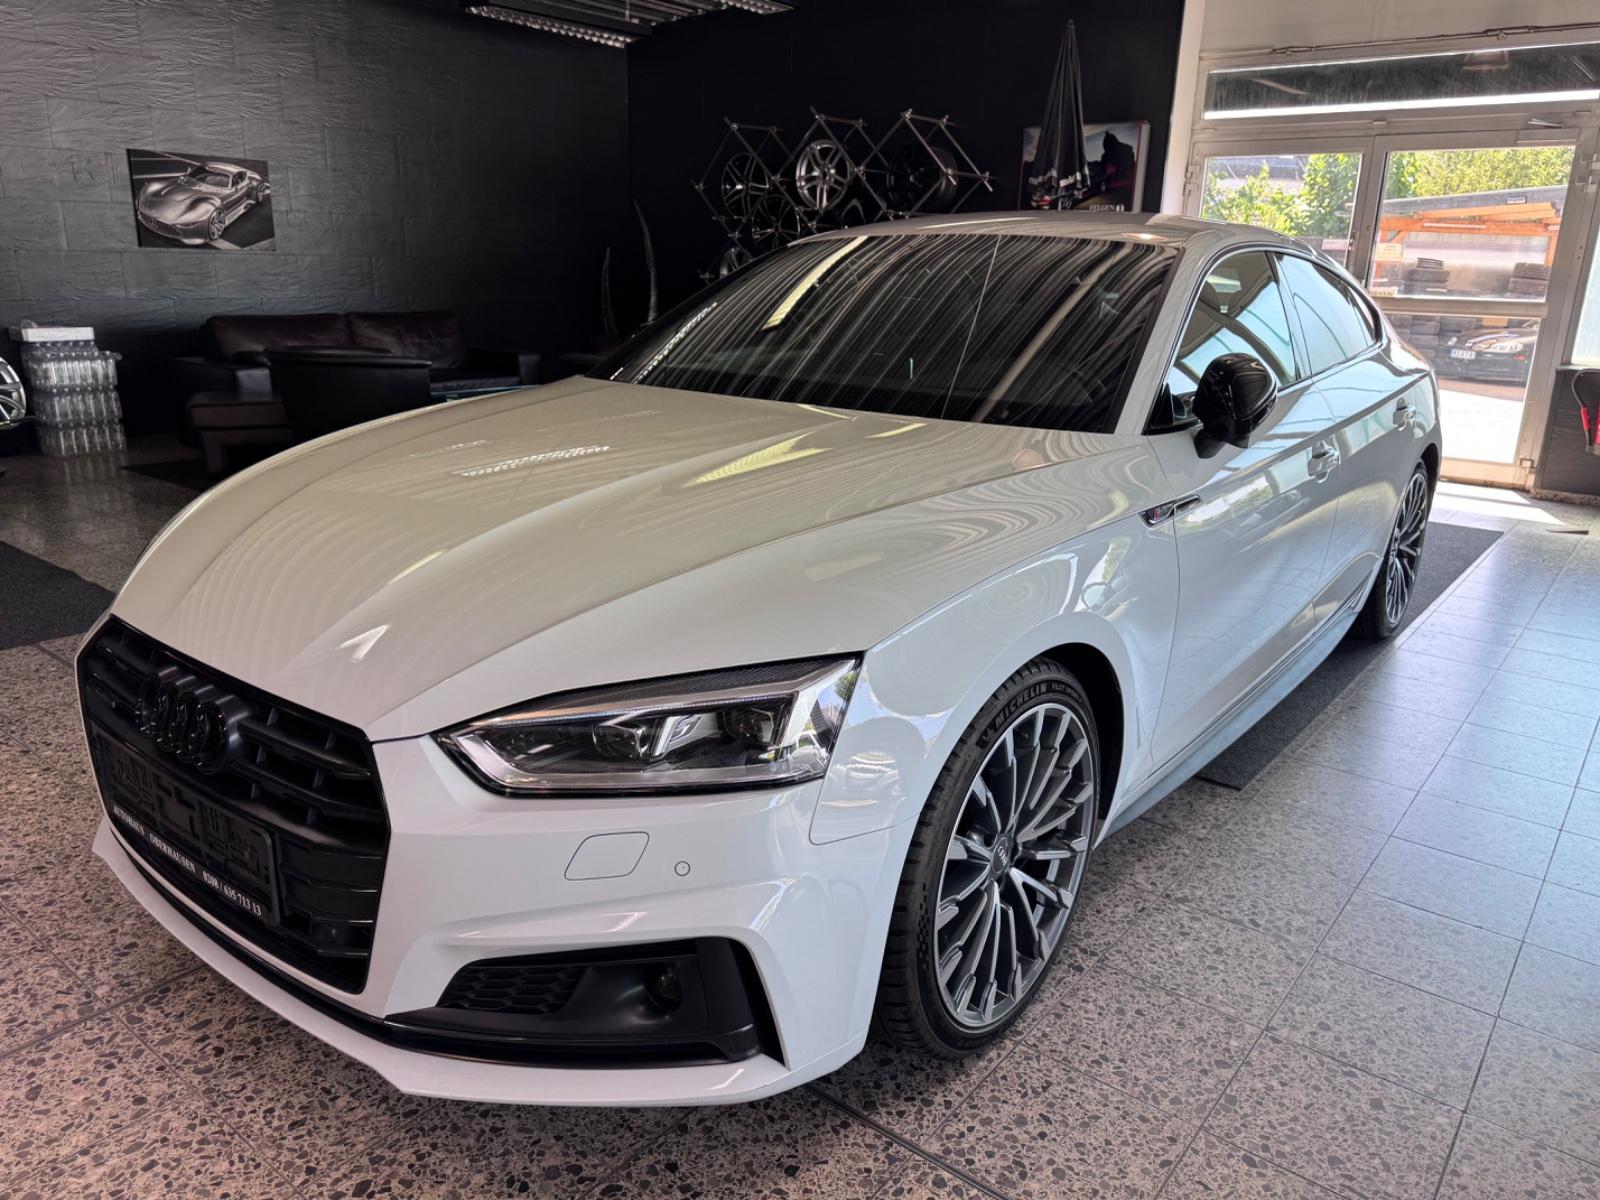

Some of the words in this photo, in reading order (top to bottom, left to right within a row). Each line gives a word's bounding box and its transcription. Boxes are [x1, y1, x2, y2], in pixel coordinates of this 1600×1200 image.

[995, 682, 1047, 729] MICHELIN
[149, 832, 196, 873] OBERHAUSEN
[237, 893, 251, 910] 713
[252, 902, 262, 916] 13
